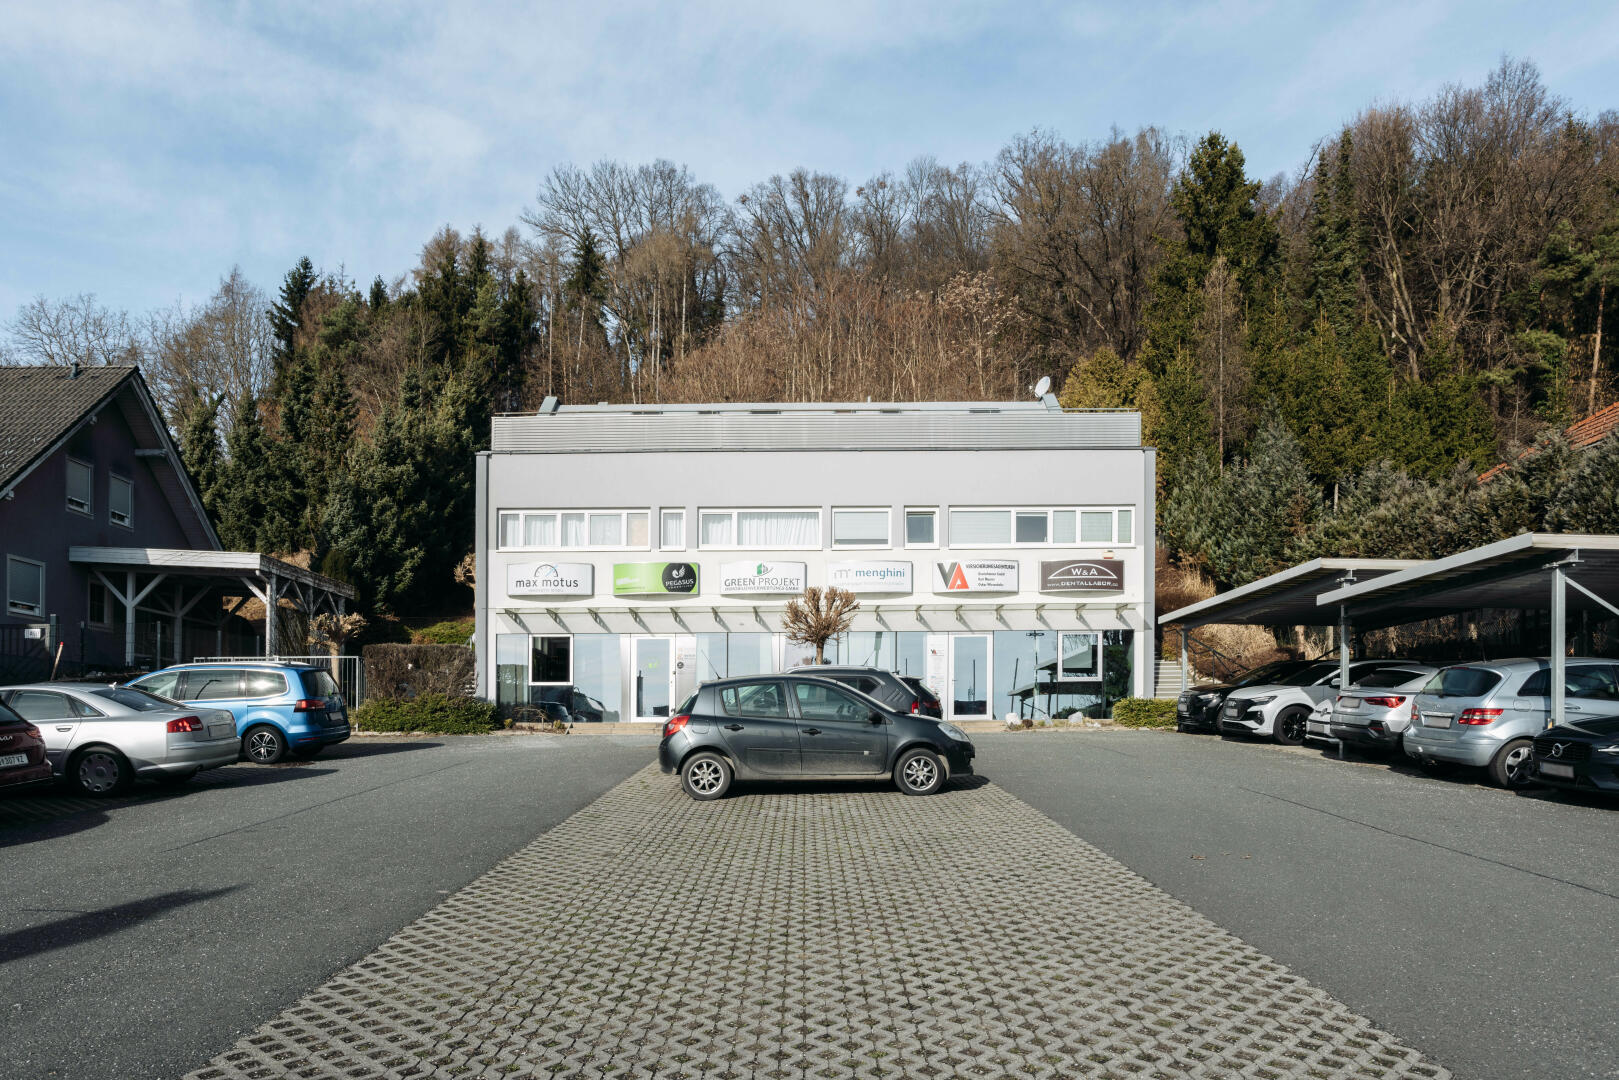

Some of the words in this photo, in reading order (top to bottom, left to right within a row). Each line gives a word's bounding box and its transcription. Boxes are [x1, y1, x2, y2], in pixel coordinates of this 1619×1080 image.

[855, 567, 906, 580] menghini
[515, 579, 538, 588] max
[541, 578, 579, 588] motus
[665, 578, 694, 587] PEGASUS
[724, 577, 756, 588] GREEN
[758, 577, 801, 587] PROJEKT
